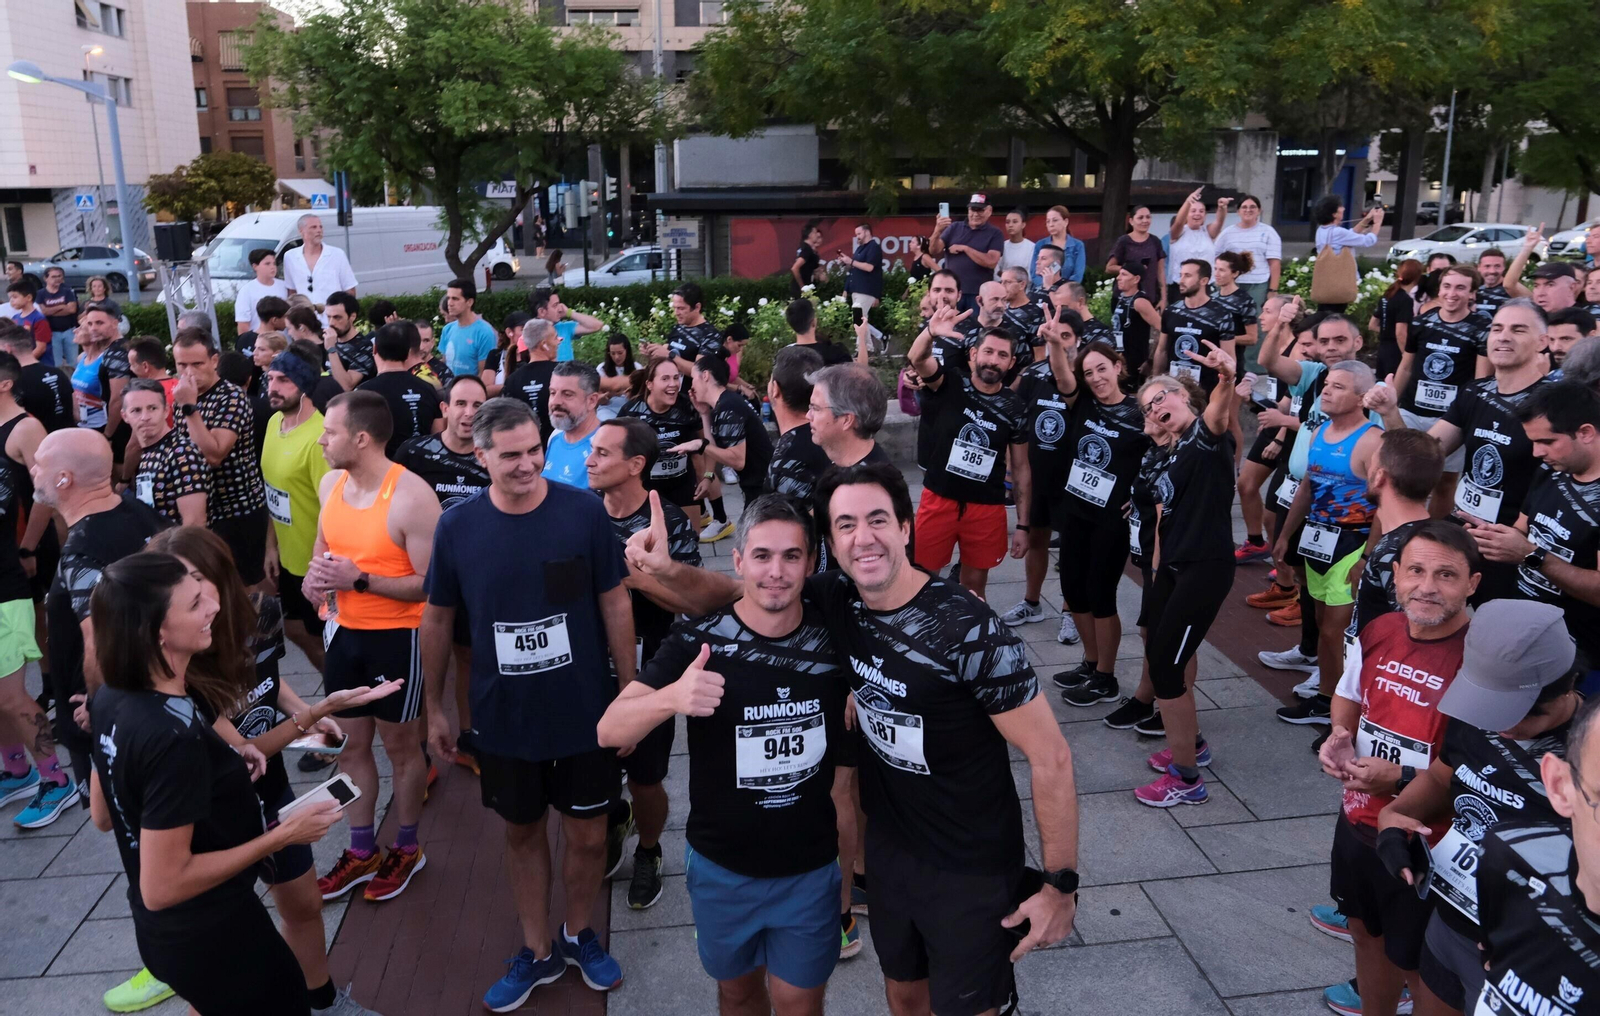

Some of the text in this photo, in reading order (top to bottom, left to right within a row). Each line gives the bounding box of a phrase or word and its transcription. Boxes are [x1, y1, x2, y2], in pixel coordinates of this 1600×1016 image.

[1424, 388, 1447, 400] 1305
[661, 461, 679, 471] 990
[962, 450, 984, 466] 385
[1081, 471, 1101, 488] 126
[1313, 530, 1321, 542] 8
[515, 631, 549, 652] 450
[1376, 656, 1444, 690] LOBOS
[1375, 676, 1430, 707] TRAIL
[744, 699, 820, 721] RUNMONES
[866, 714, 896, 745] 587
[764, 734, 805, 760] 943
[1371, 739, 1402, 765] 168
[1455, 764, 1525, 809] RUNMONES
[1451, 843, 1477, 878] 16
[1498, 969, 1575, 1016] RUNM
